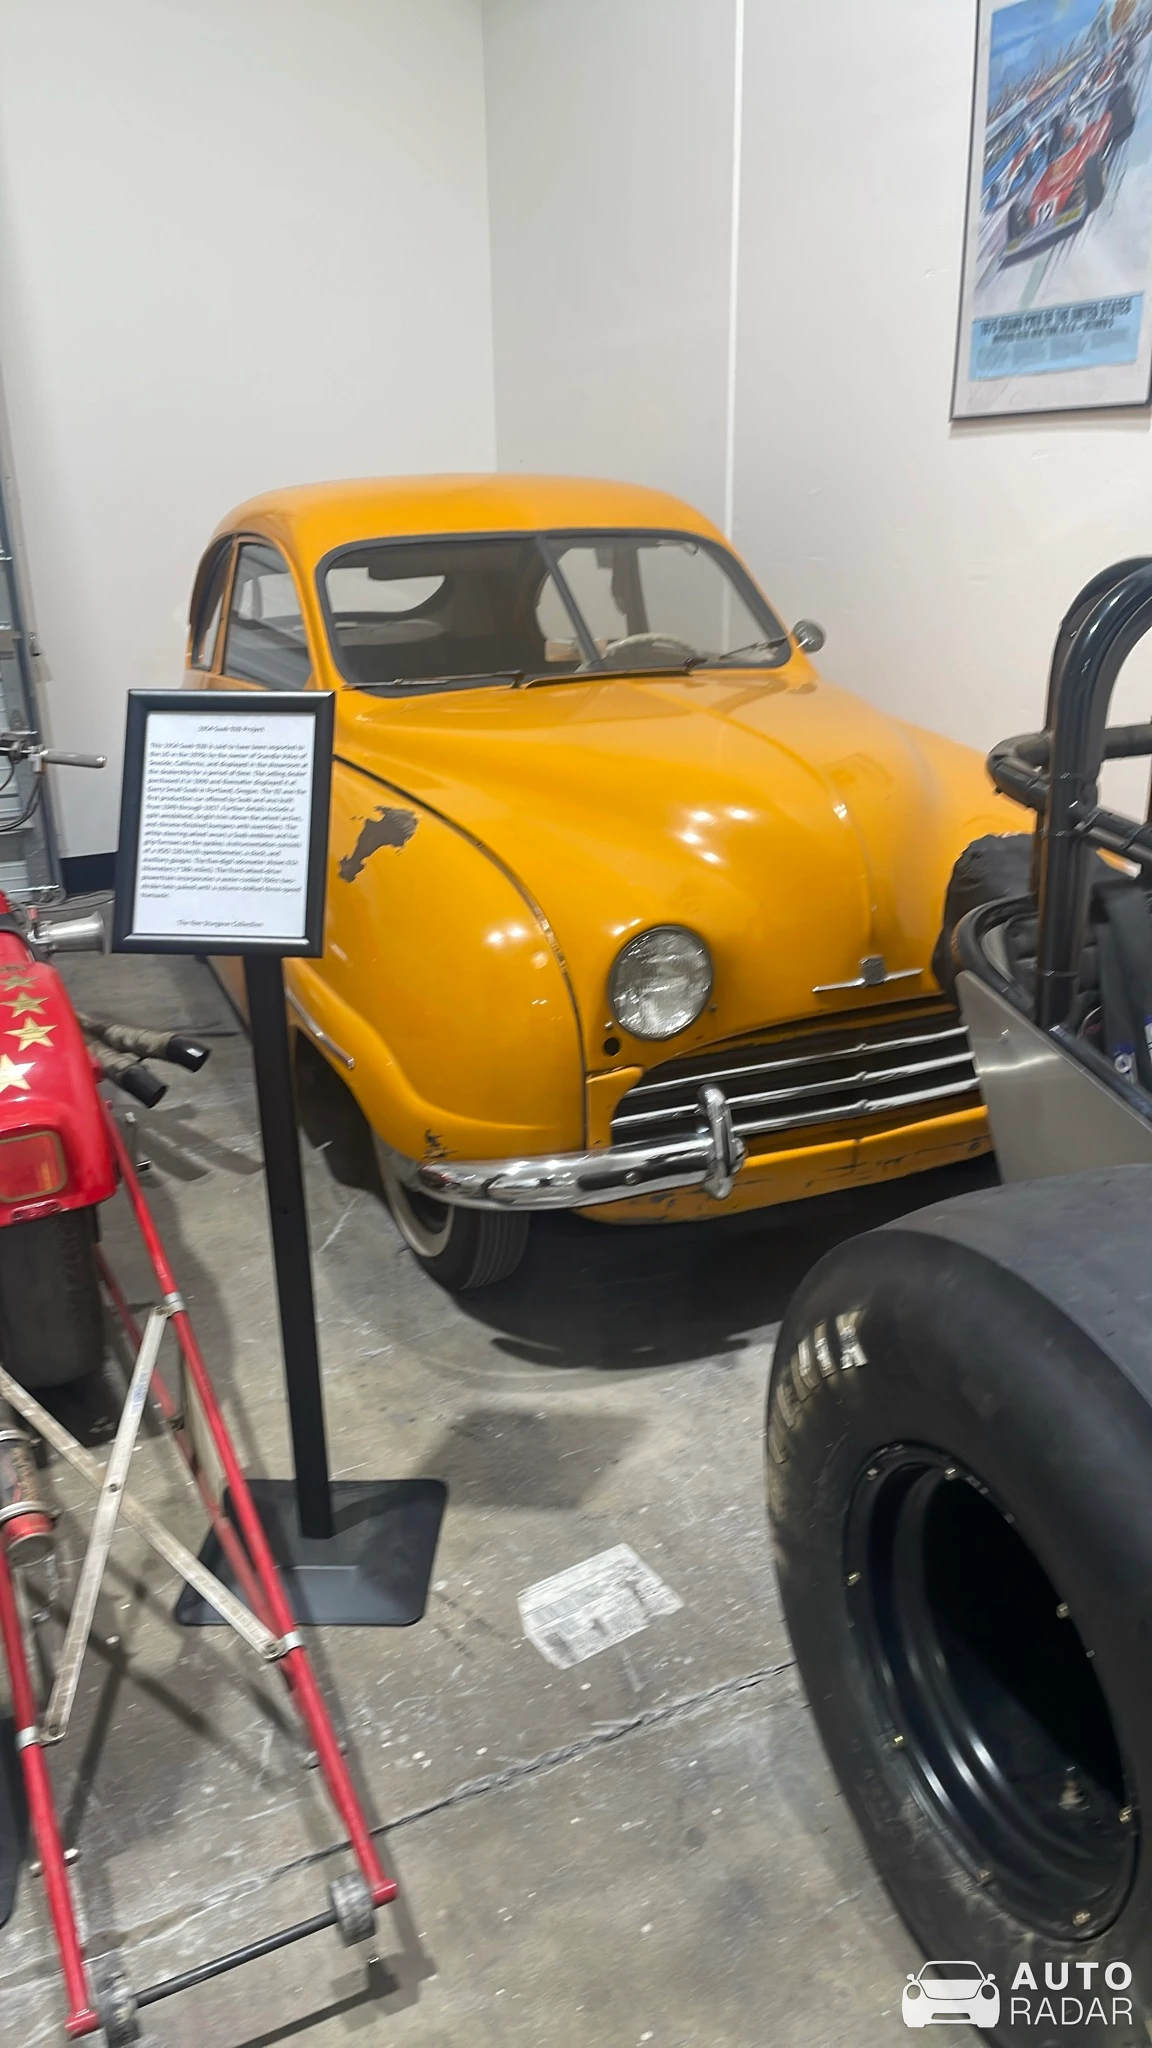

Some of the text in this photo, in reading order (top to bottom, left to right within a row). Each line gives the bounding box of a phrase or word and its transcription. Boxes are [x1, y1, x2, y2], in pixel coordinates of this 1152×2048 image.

[175, 760, 206, 768] California,
[159, 769, 192, 777] dealership
[207, 769, 228, 777] period
[266, 770, 286, 778] selling
[147, 777, 179, 785] purchased
[159, 795, 194, 803] production
[178, 804, 203, 812] through
[195, 813, 215, 821] bright
[208, 822, 235, 830] bumpers
[162, 830, 188, 838] steering
[202, 840, 226, 848] spokes.
[142, 857, 169, 865] auxiliary
[206, 858, 234, 866] five-digit
[141, 875, 175, 883] powertrain
[176, 875, 215, 883] incorporates
[176, 884, 196, 892] paired
